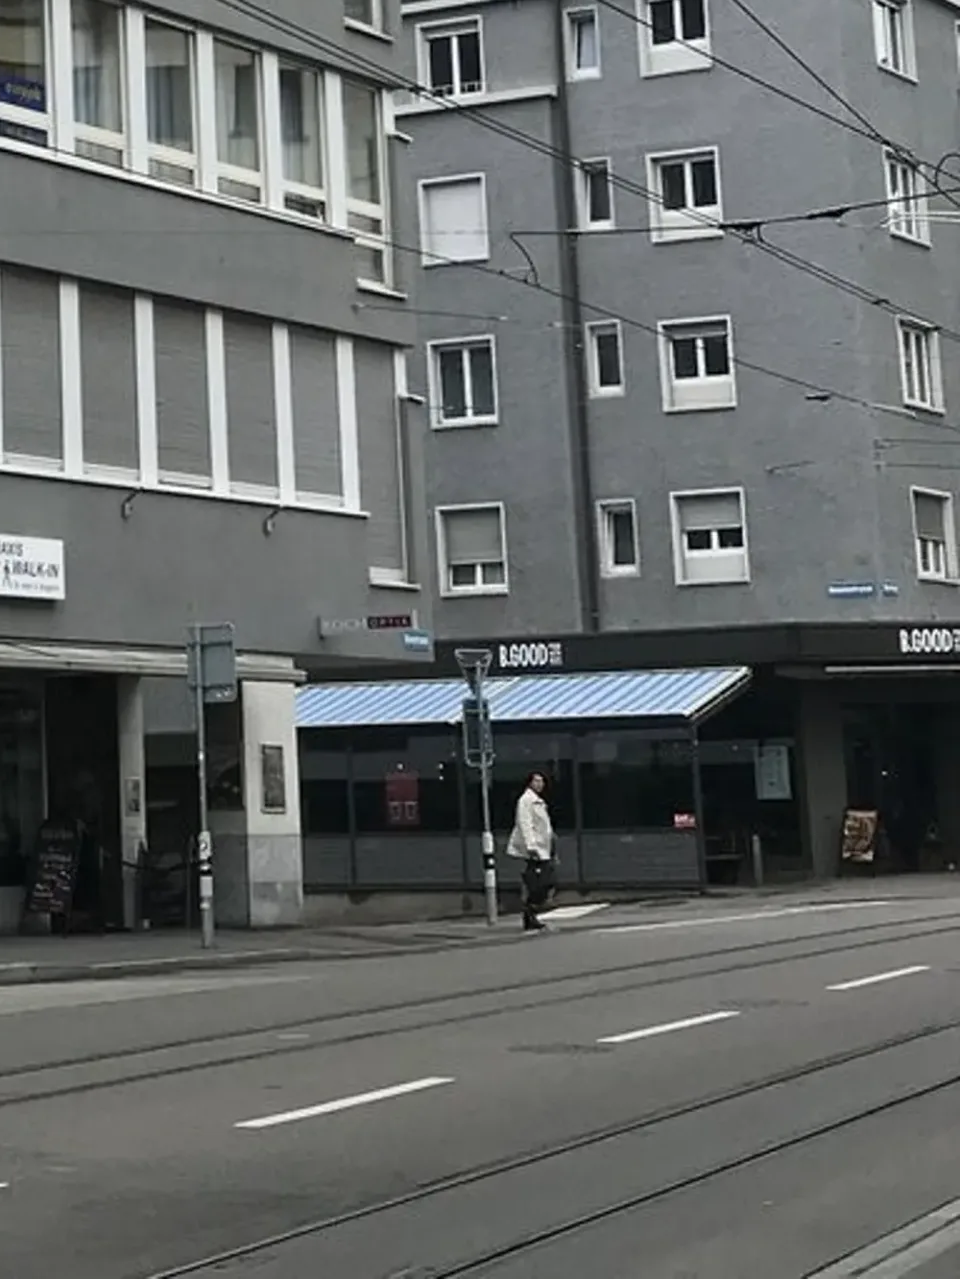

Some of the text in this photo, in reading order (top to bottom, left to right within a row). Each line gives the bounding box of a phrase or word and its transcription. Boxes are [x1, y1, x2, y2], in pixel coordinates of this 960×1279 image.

[12, 561, 61, 578] WALK-IN
[900, 628, 953, 653] B.GOOD
[499, 643, 548, 668] B.GOOD
